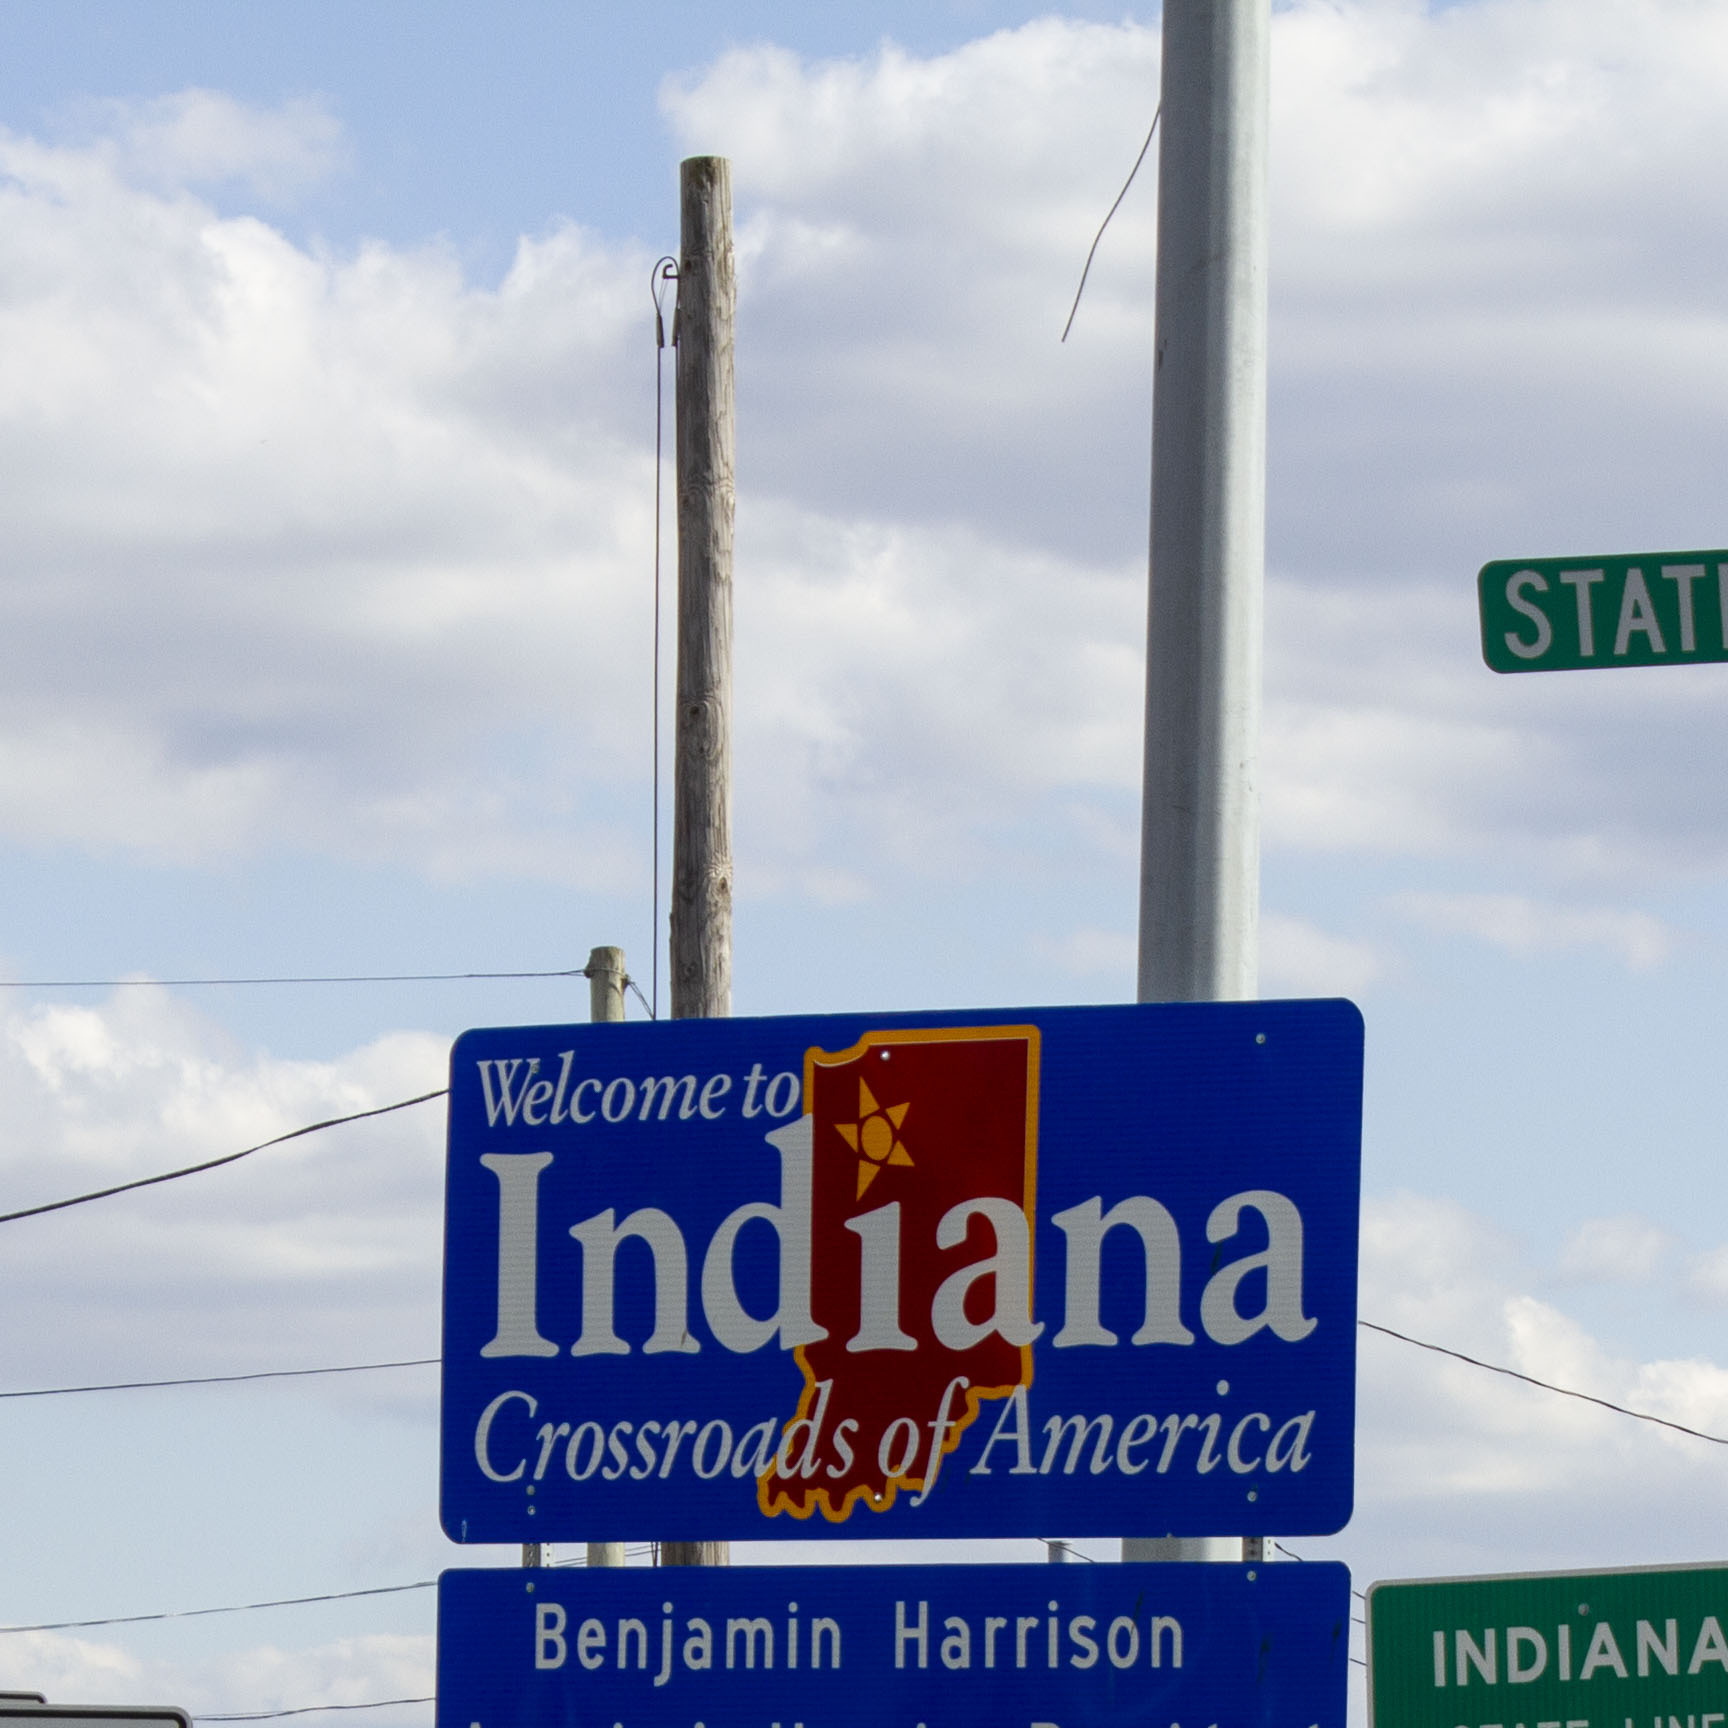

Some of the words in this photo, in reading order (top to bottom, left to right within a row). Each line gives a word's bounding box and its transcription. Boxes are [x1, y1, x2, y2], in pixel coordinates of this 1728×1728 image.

[476, 1050, 733, 1128] Welcome
[740, 1061, 802, 1118] to
[479, 1113, 1318, 1358] Indiana
[475, 1378, 859, 1483] Crossroads
[878, 1375, 970, 1507] of
[970, 1379, 1317, 1477] America
[535, 1601, 842, 1687] Benjamin
[894, 1600, 1184, 1670] Harrison
